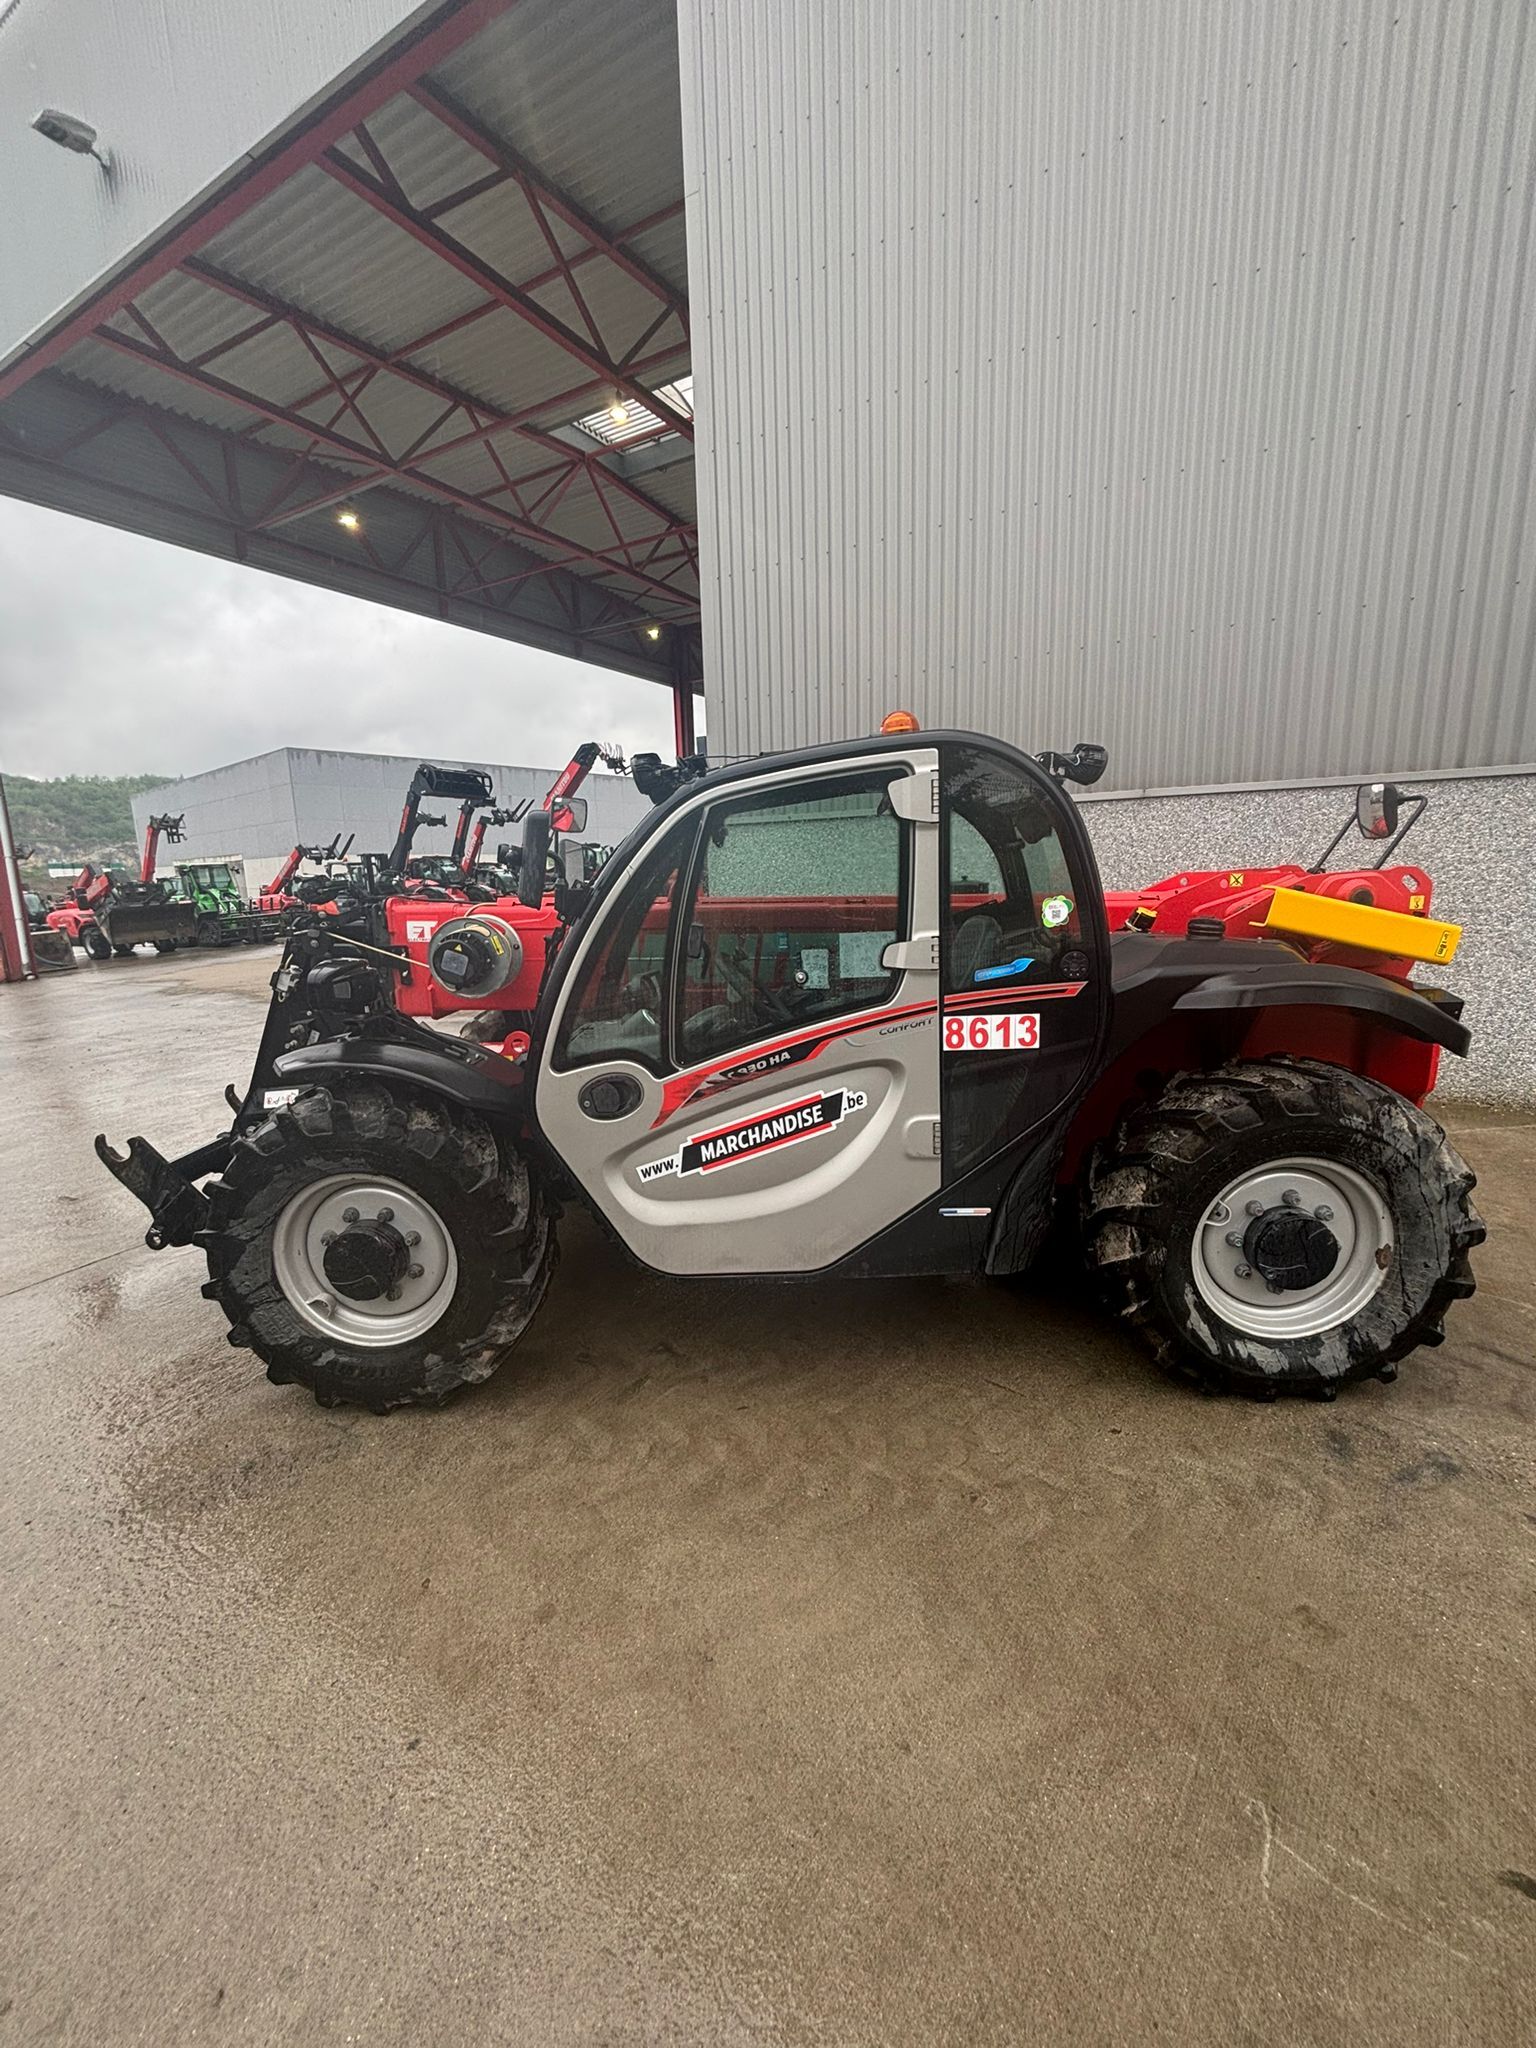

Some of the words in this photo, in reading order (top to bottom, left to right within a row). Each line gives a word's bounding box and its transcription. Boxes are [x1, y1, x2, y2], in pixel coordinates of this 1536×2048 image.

[945, 1015, 1038, 1049] 8613
[769, 1051, 791, 1066] HA
[700, 1104, 823, 1163] MARCHANDISE
